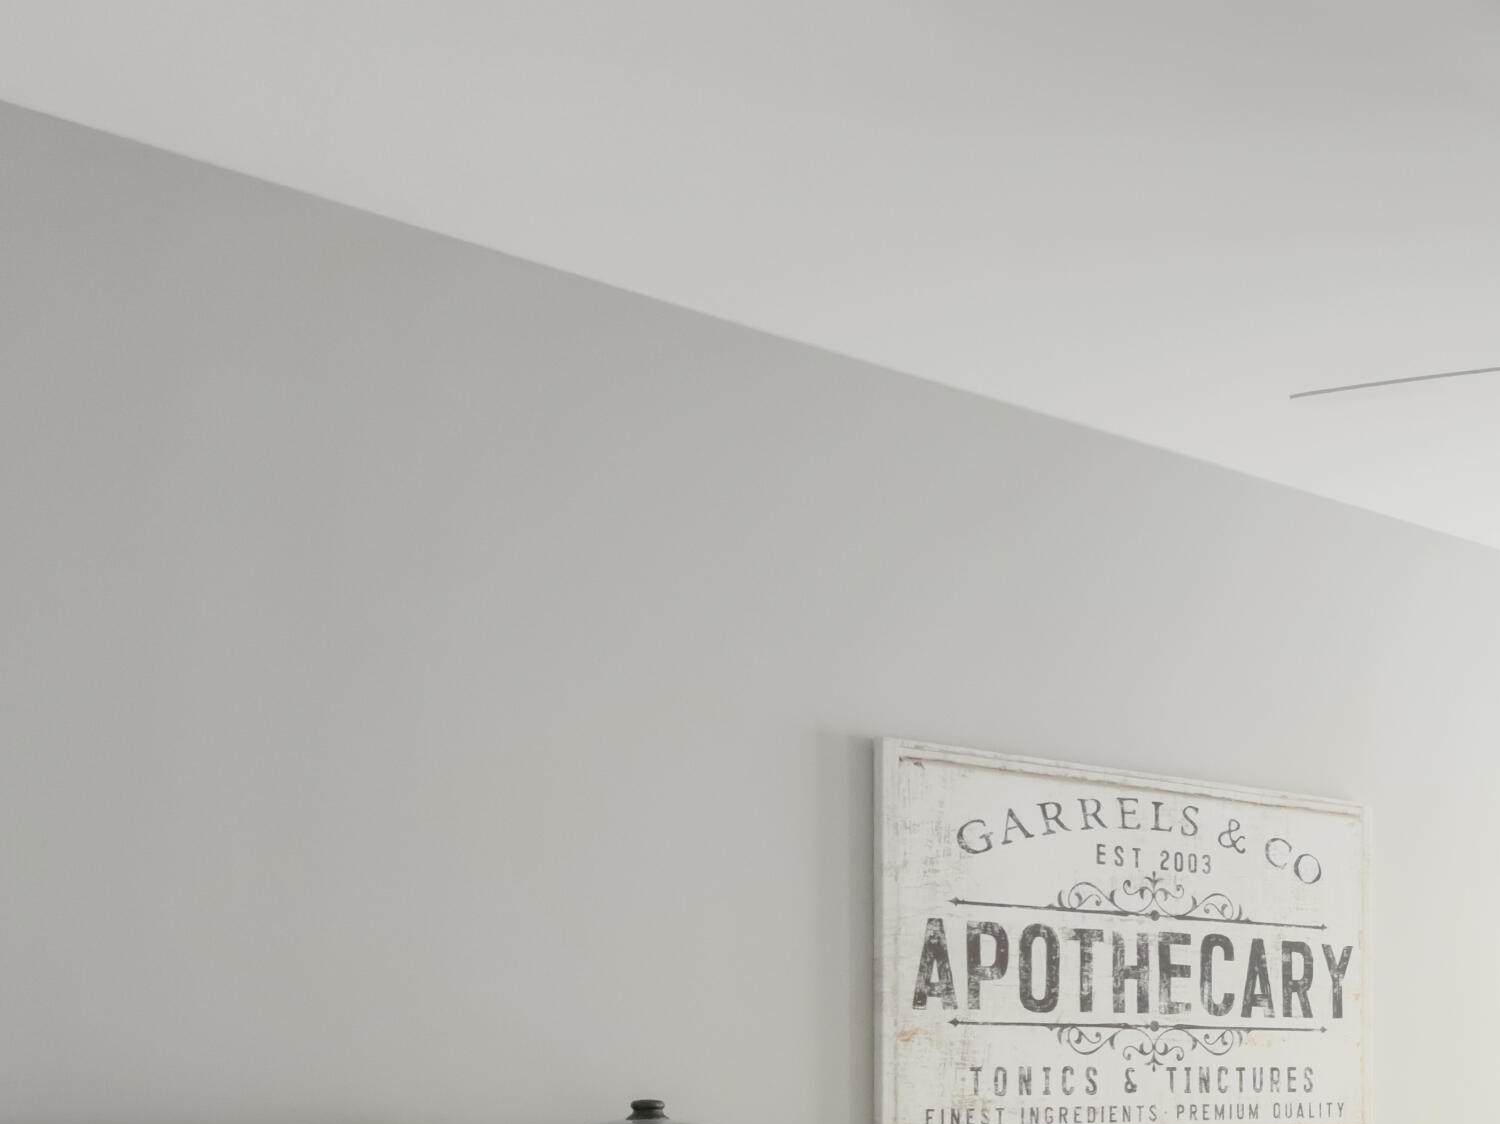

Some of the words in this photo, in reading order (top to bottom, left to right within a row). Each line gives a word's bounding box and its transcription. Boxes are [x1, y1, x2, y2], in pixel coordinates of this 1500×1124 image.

[957, 797, 1199, 854] GARRELS
[1218, 819, 1246, 854] &
[1265, 837, 1322, 885] CO
[1096, 844, 1141, 868] EST
[1160, 850, 1212, 874] 2003
[911, 917, 1354, 1020] APOTHECARY
[969, 1066, 1098, 1096] TONICS
[1124, 1067, 1138, 1094] &
[1166, 1066, 1314, 1093] TINCTURES
[1020, 1104, 1158, 1124] INGREDIENTS
[1176, 1103, 1259, 1121] PREMIUM
[1273, 1102, 1345, 1119] QUALITY
